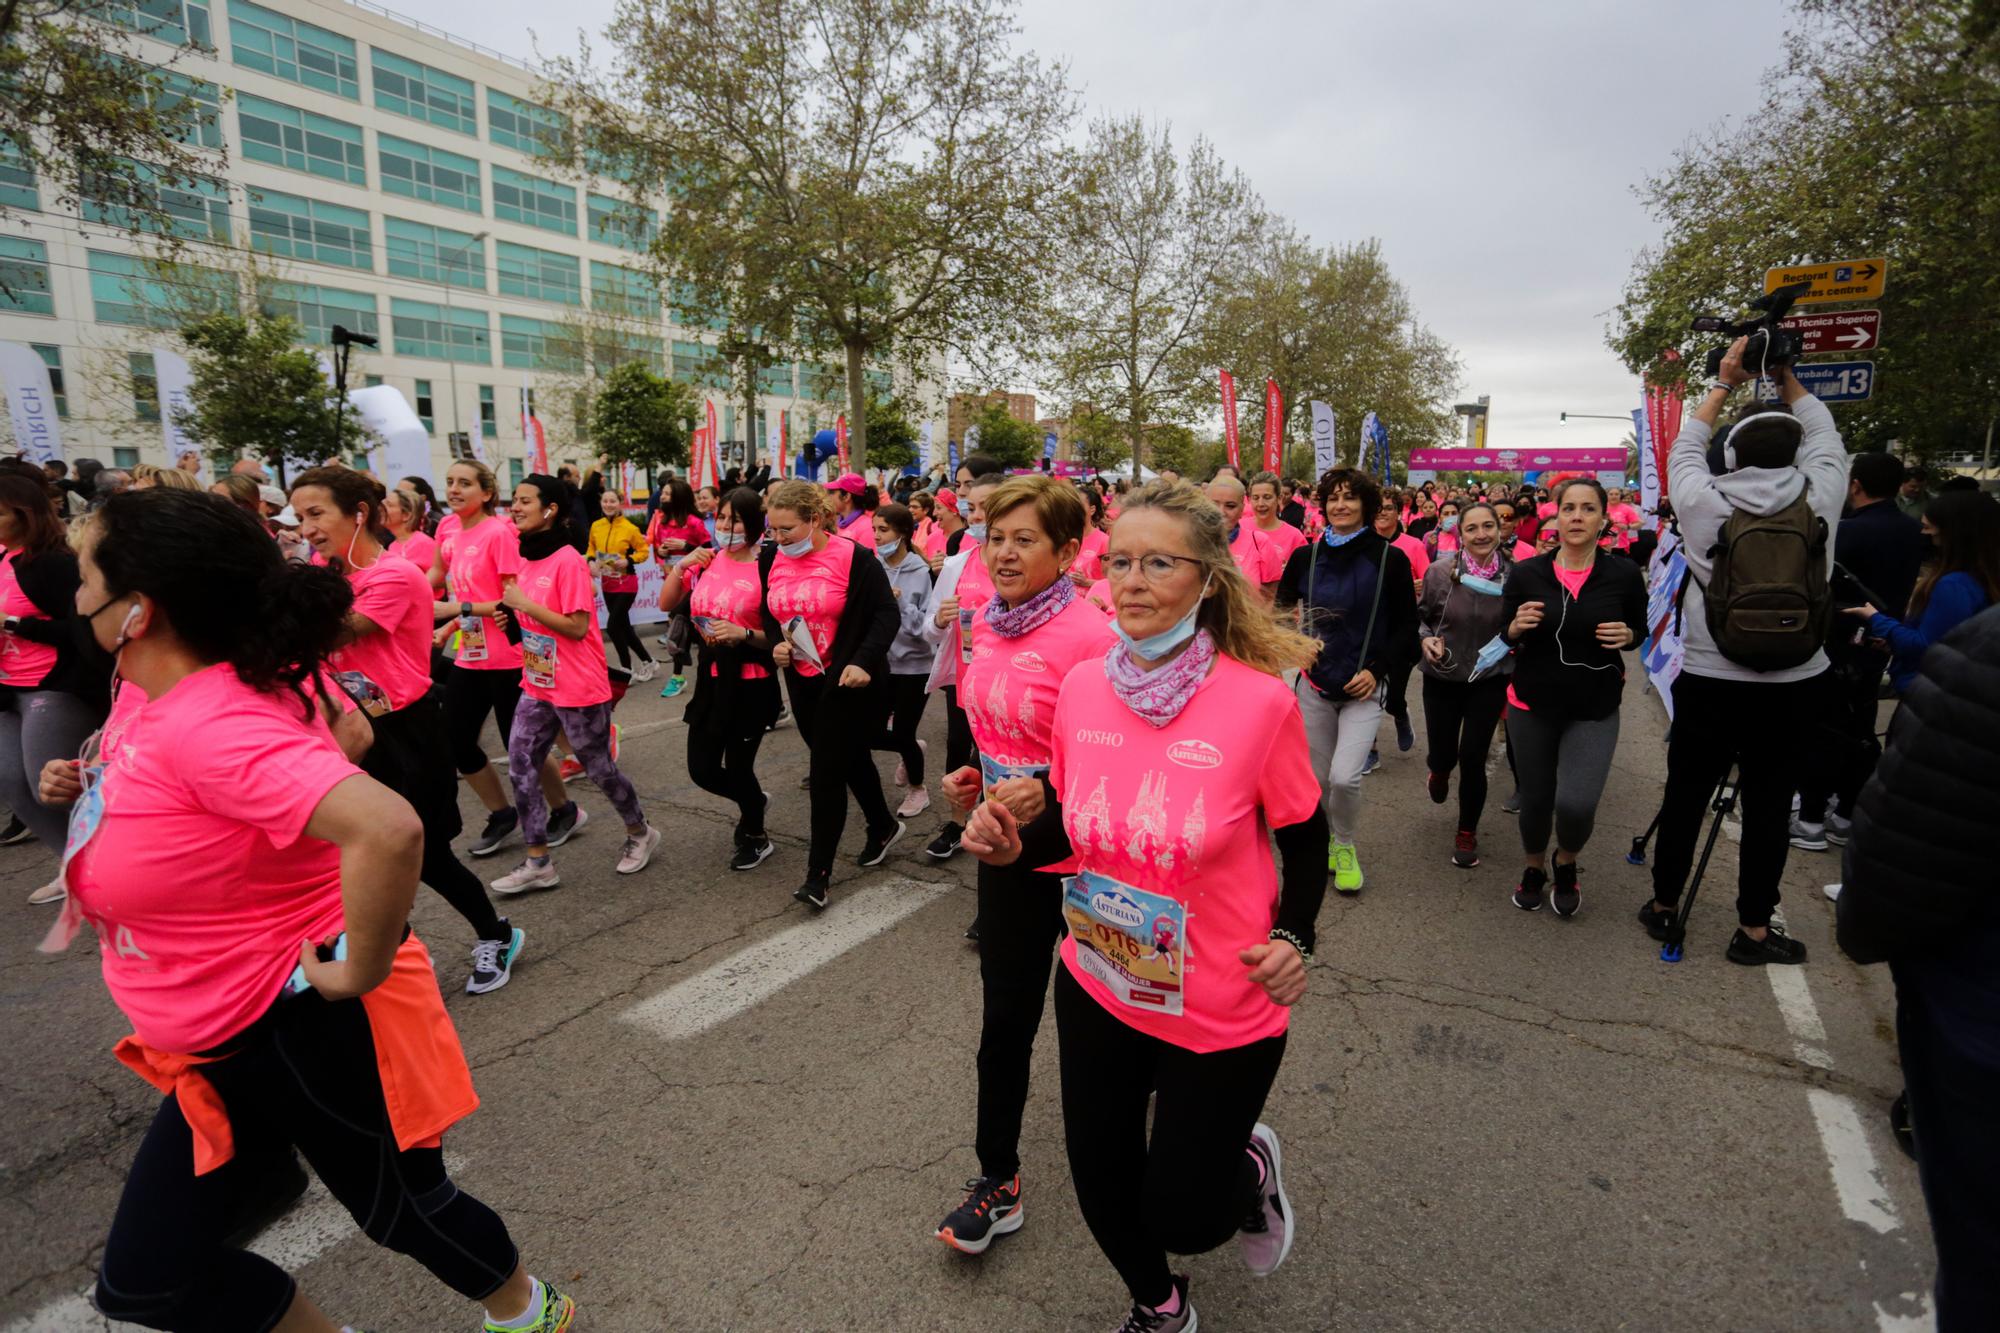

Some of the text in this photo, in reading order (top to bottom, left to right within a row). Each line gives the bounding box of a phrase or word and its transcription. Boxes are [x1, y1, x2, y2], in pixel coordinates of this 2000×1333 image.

[1783, 271, 1828, 283] Rectorat
[1827, 285, 1868, 296] centres
[1836, 314, 1877, 325] Superior
[1797, 368, 1869, 395] trobada 13
[1076, 728, 1124, 748] OYSHO
[1094, 897, 1141, 925] ASTURIANA
[1083, 953, 1108, 981] OYSHO
